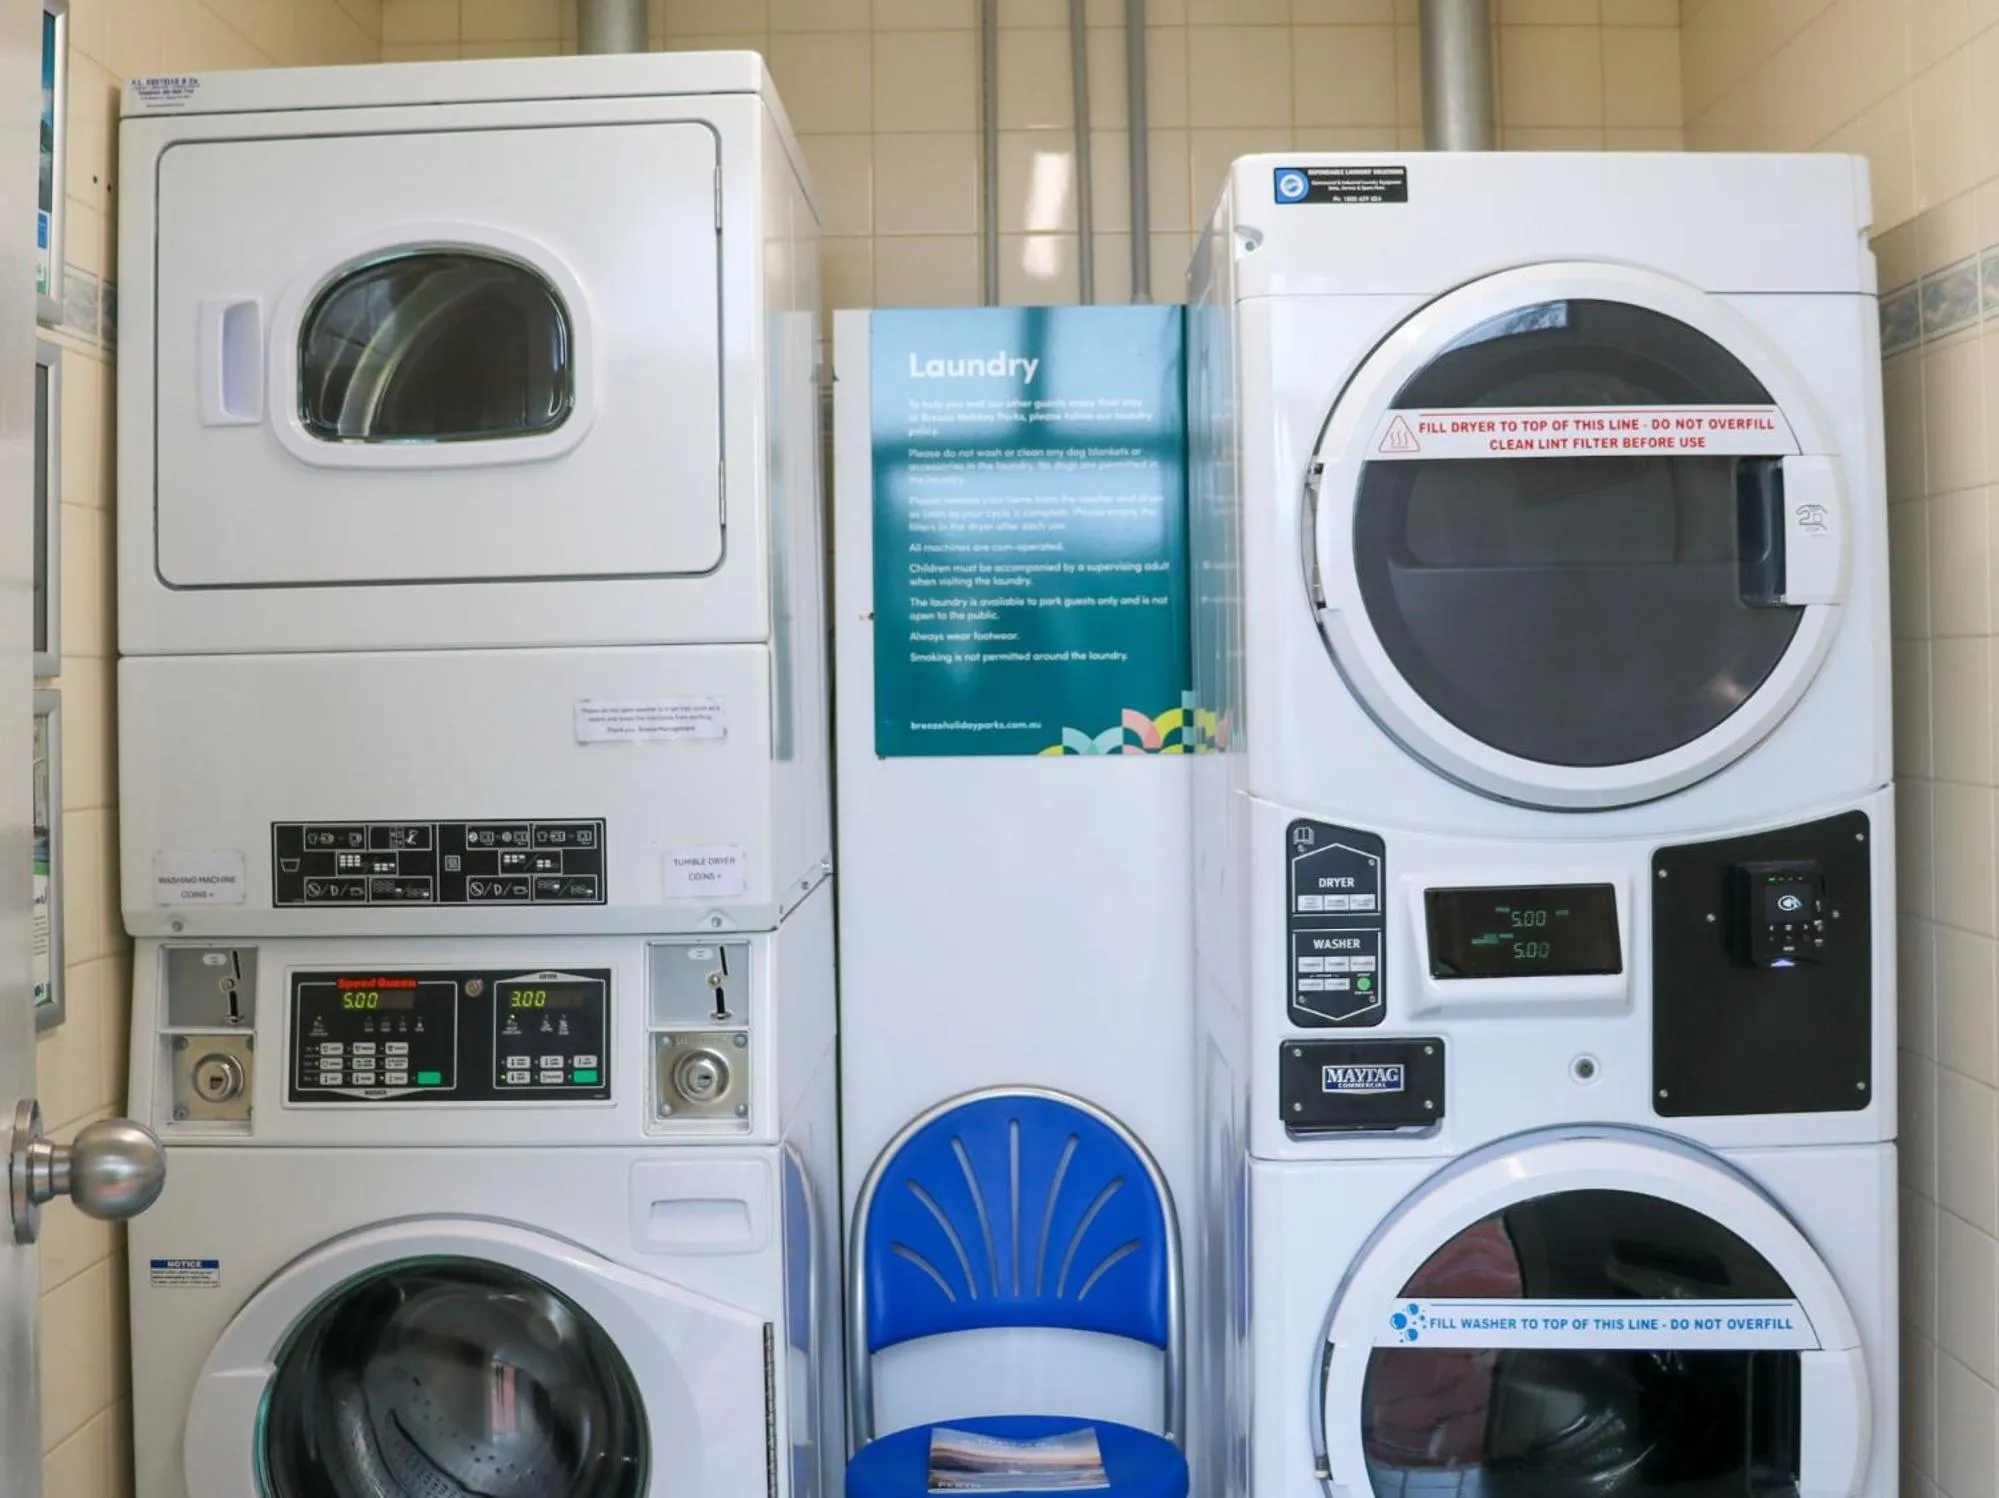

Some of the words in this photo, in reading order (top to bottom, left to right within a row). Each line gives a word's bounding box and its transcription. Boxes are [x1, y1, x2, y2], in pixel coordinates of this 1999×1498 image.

[909, 351, 1039, 384] Laundry
[1418, 422, 1447, 433] FILL
[1451, 421, 1496, 433] DRYER
[1501, 420, 1518, 432] TO
[1521, 420, 1548, 432] TOP
[1551, 420, 1570, 431] OF
[1573, 419, 1605, 431] THIS
[1609, 419, 1640, 430] LINE
[1652, 419, 1671, 430] DO
[1675, 419, 1704, 430] NOT
[1708, 418, 1775, 430] OVERFILL
[1489, 438, 1534, 450] CLEAN
[1540, 438, 1569, 449] LINT
[1573, 437, 1619, 449] FILTER
[1623, 436, 1675, 448] BEFORE
[1679, 436, 1706, 448] USE
[908, 448, 941, 457] Please
[943, 448, 956, 457] do
[959, 448, 974, 457] not
[977, 448, 1002, 457] wash
[1004, 449, 1015, 457] or
[1017, 448, 1044, 457] clean
[1046, 449, 1064, 459] any
[1066, 448, 1086, 459] dog
[1088, 448, 1129, 456] blankets
[909, 543, 921, 552] All
[923, 543, 970, 552] machines
[909, 563, 951, 572] Children
[953, 563, 977, 572] must
[979, 563, 992, 572] be
[994, 563, 1061, 574] accompanied
[1063, 562, 1076, 574] by
[1077, 563, 1086, 571] a
[1087, 562, 1142, 573] supervising
[1144, 562, 1170, 571] adult
[909, 577, 937, 586] when
[939, 577, 973, 588] visiting
[974, 577, 990, 585] the
[909, 597, 928, 607] The
[929, 597, 967, 609] laundry
[969, 597, 977, 606] is
[980, 597, 1025, 606] available
[1027, 597, 1037, 606] to
[1039, 597, 1062, 608] park
[1064, 596, 1095, 608] guests
[1097, 596, 1118, 608] only
[1120, 596, 1140, 605] and
[1142, 596, 1149, 605] is
[1151, 596, 1168, 605] not
[909, 613, 935, 623] open
[937, 611, 947, 620] to
[949, 611, 965, 620] the
[966, 611, 1000, 622] public.
[909, 632, 944, 643] Always
[946, 633, 971, 641] wear
[973, 632, 1019, 640] footwear.
[910, 652, 952, 664] Smoking
[954, 652, 962, 662] is
[964, 652, 981, 661] not
[982, 652, 1031, 664] permitted
[1033, 652, 1069, 661] around
[1071, 651, 1087, 660] the
[1088, 651, 1128, 663] laundry.
[910, 721, 1042, 732] breezeholidayparks.com.au
[673, 858, 705, 866] TUMBLE
[707, 856, 736, 866] DRYER
[158, 876, 198, 885] WASHING
[199, 875, 236, 884] MACHINE
[688, 872, 716, 881] COINS
[1318, 877, 1355, 888] DRYER
[181, 890, 207, 899] COINS
[1511, 910, 1547, 927] 5.00
[1313, 938, 1361, 950] WASHER
[1513, 942, 1550, 959] 5.00
[337, 977, 376, 989] Speed
[377, 977, 417, 988] Queen
[344, 992, 378, 1009] 5.00
[511, 990, 547, 1008] 3.00
[1327, 1068, 1399, 1082] MAYTAG
[1337, 1081, 1386, 1089] COMMERCIAL
[167, 1260, 203, 1268] NOTICE
[1429, 1318, 1456, 1329] FILL
[1460, 1318, 1516, 1330] WASHER
[1521, 1318, 1538, 1330] TO
[1542, 1318, 1568, 1330] TOP
[1572, 1318, 1590, 1330] OF
[1594, 1318, 1625, 1330] THIS
[1628, 1318, 1659, 1330] LINE
[1671, 1318, 1690, 1330] DO
[1694, 1318, 1722, 1330] NOT
[1727, 1318, 1794, 1330] OVERFILL
